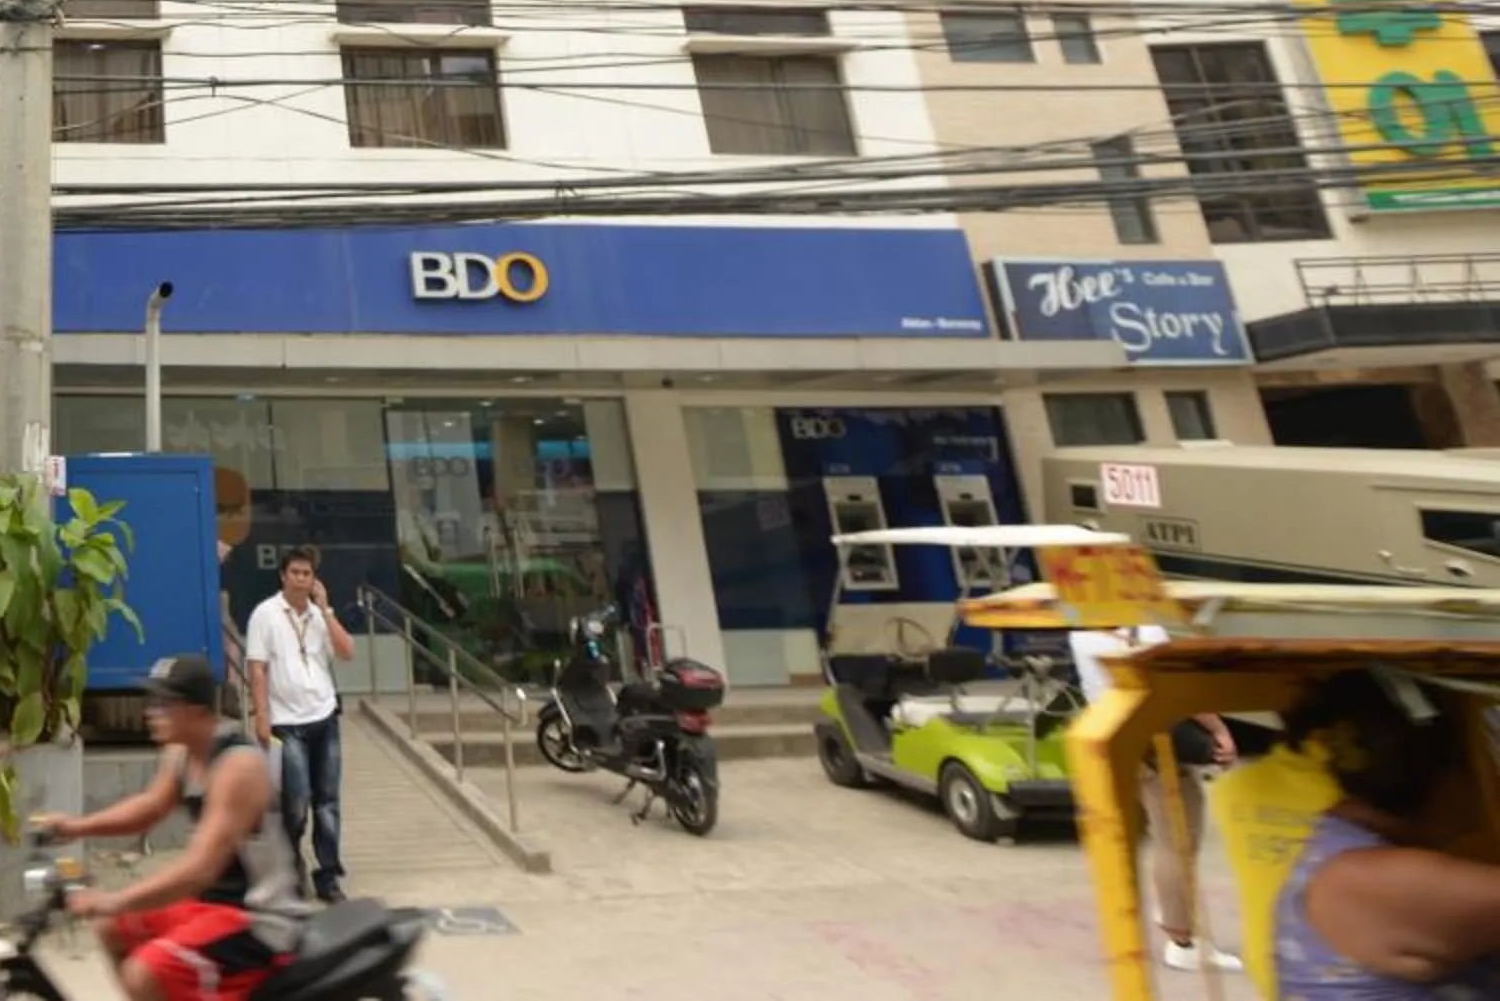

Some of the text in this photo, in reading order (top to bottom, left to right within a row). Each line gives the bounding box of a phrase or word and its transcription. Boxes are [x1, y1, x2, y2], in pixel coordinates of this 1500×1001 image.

[411, 251, 549, 303] BDO
[1109, 301, 1229, 355] Story
[790, 416, 847, 440] BDO
